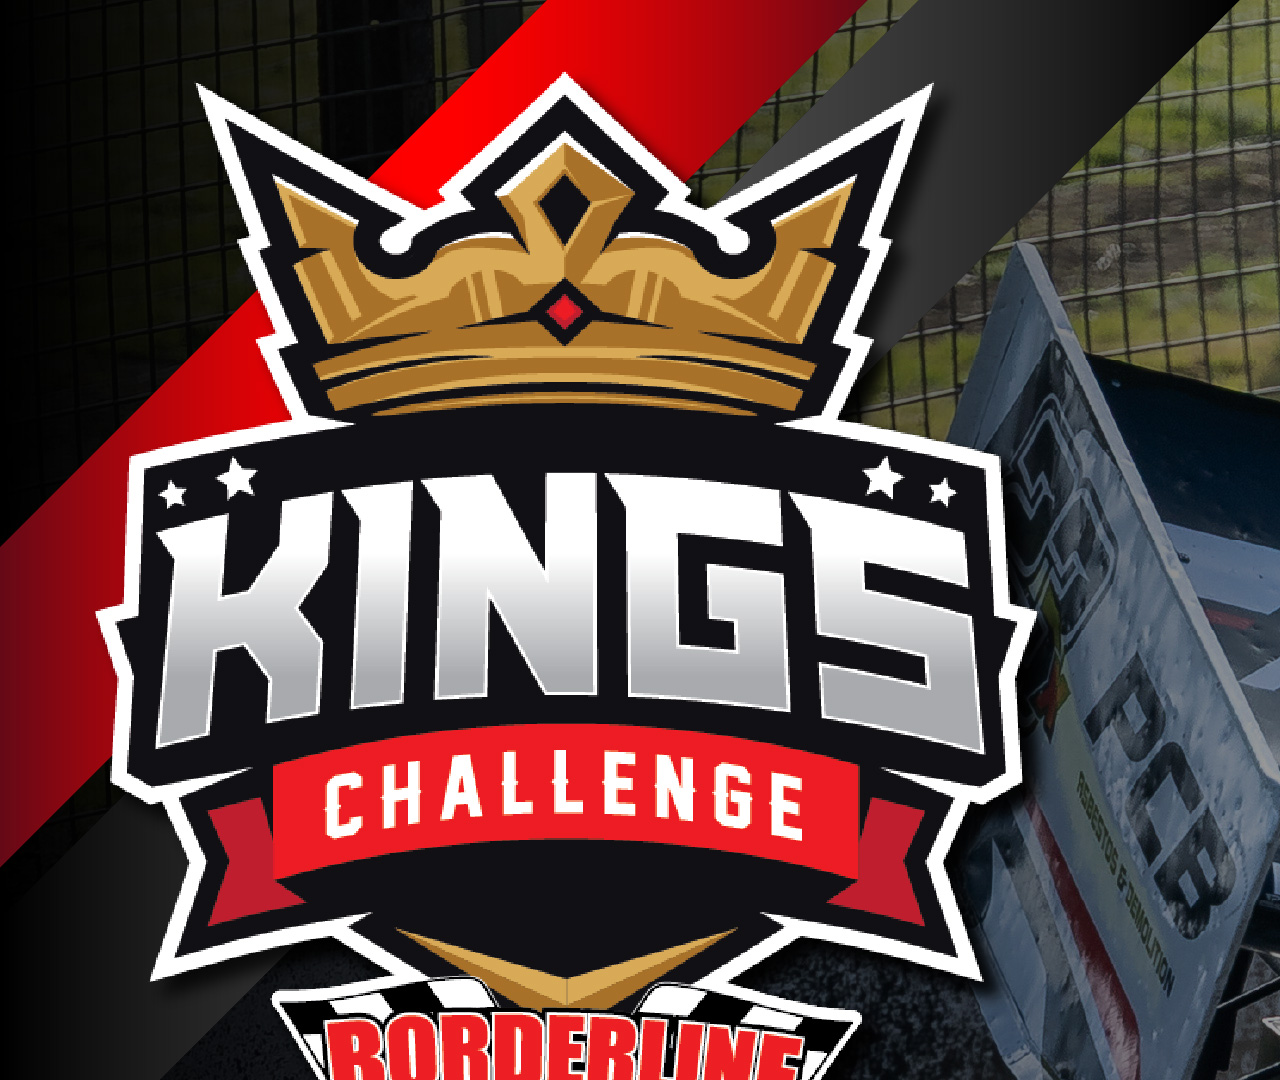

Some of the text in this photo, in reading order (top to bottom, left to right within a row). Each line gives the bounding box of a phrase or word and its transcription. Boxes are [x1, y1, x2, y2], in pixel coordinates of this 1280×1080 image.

[1077, 771, 1119, 876] ASBESTOS
[1124, 884, 1175, 998] DEMOLITION
[1083, 652, 1237, 939] PCB
